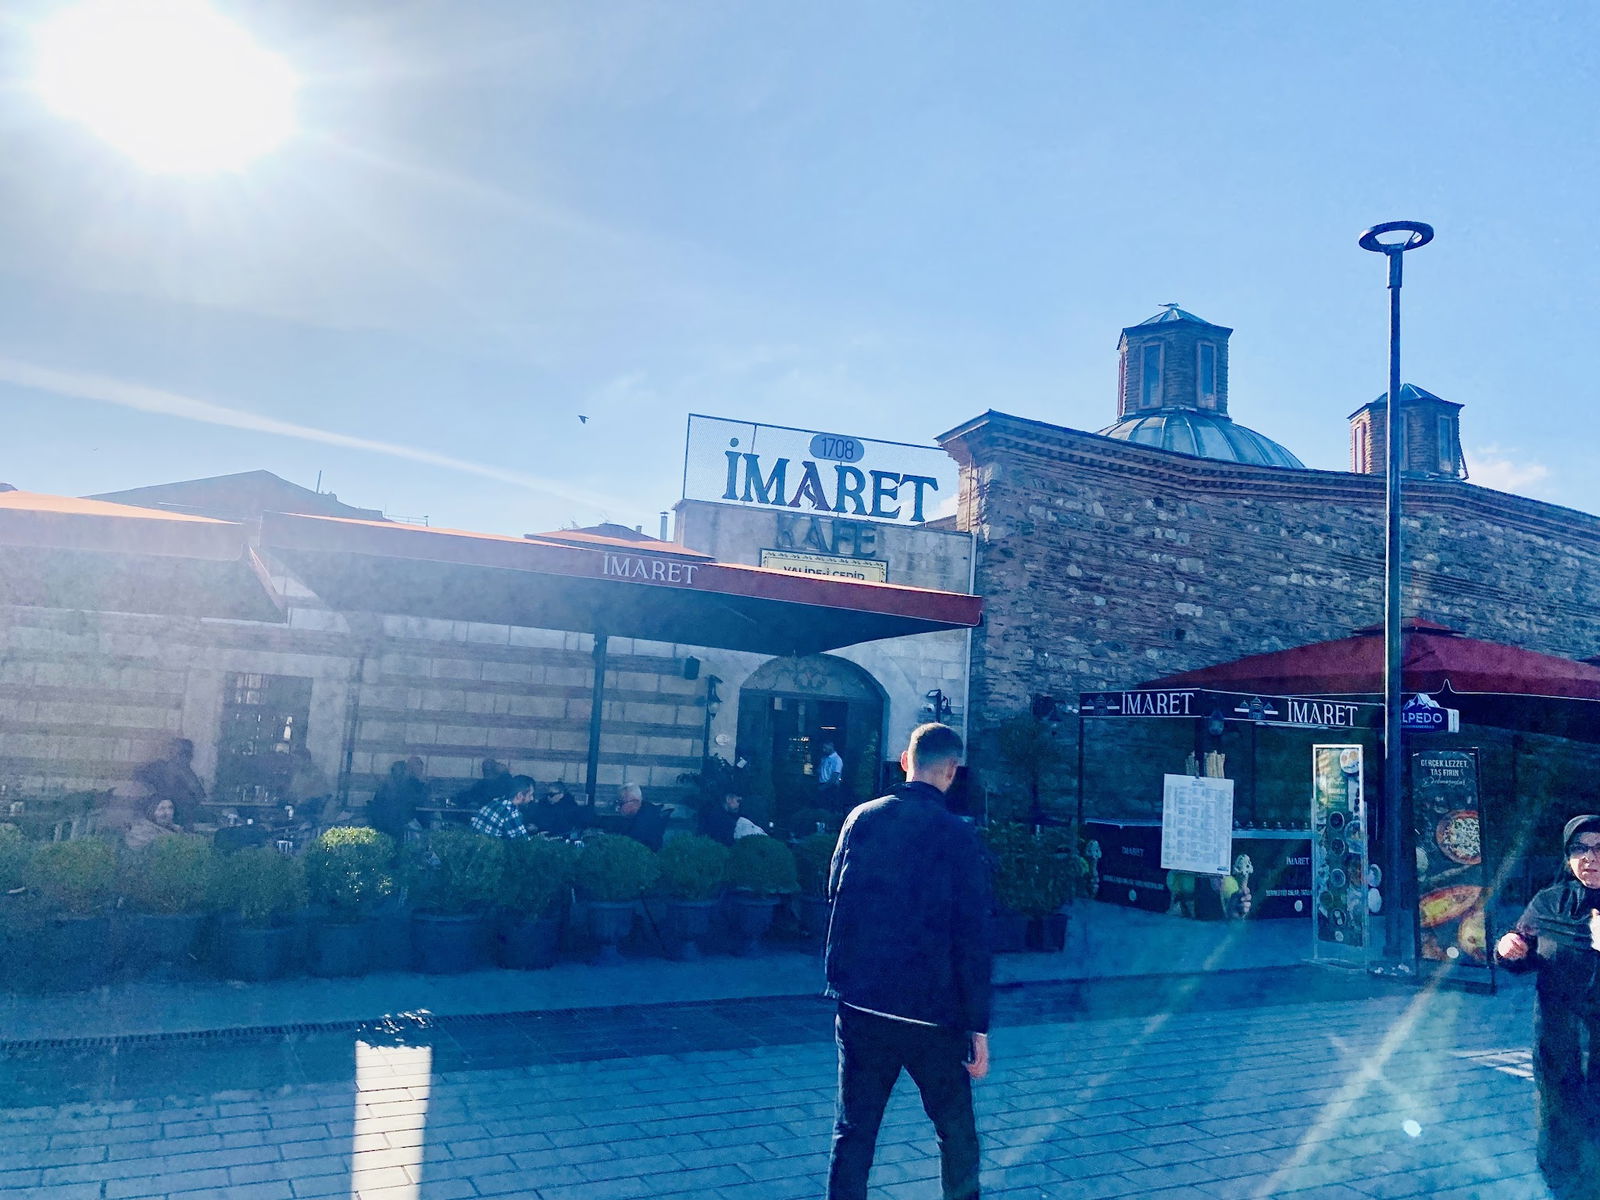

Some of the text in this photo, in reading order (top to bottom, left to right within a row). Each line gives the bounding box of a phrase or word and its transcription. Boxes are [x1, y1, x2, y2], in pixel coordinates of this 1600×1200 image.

[821, 437, 855, 460] 1708
[721, 437, 940, 523] İMARET
[776, 513, 877, 558] KAFE
[602, 551, 699, 585] İMARET
[1121, 691, 1195, 715] İMARET
[1287, 698, 1359, 726] İMARET
[1401, 712, 1443, 724] LPEDO
